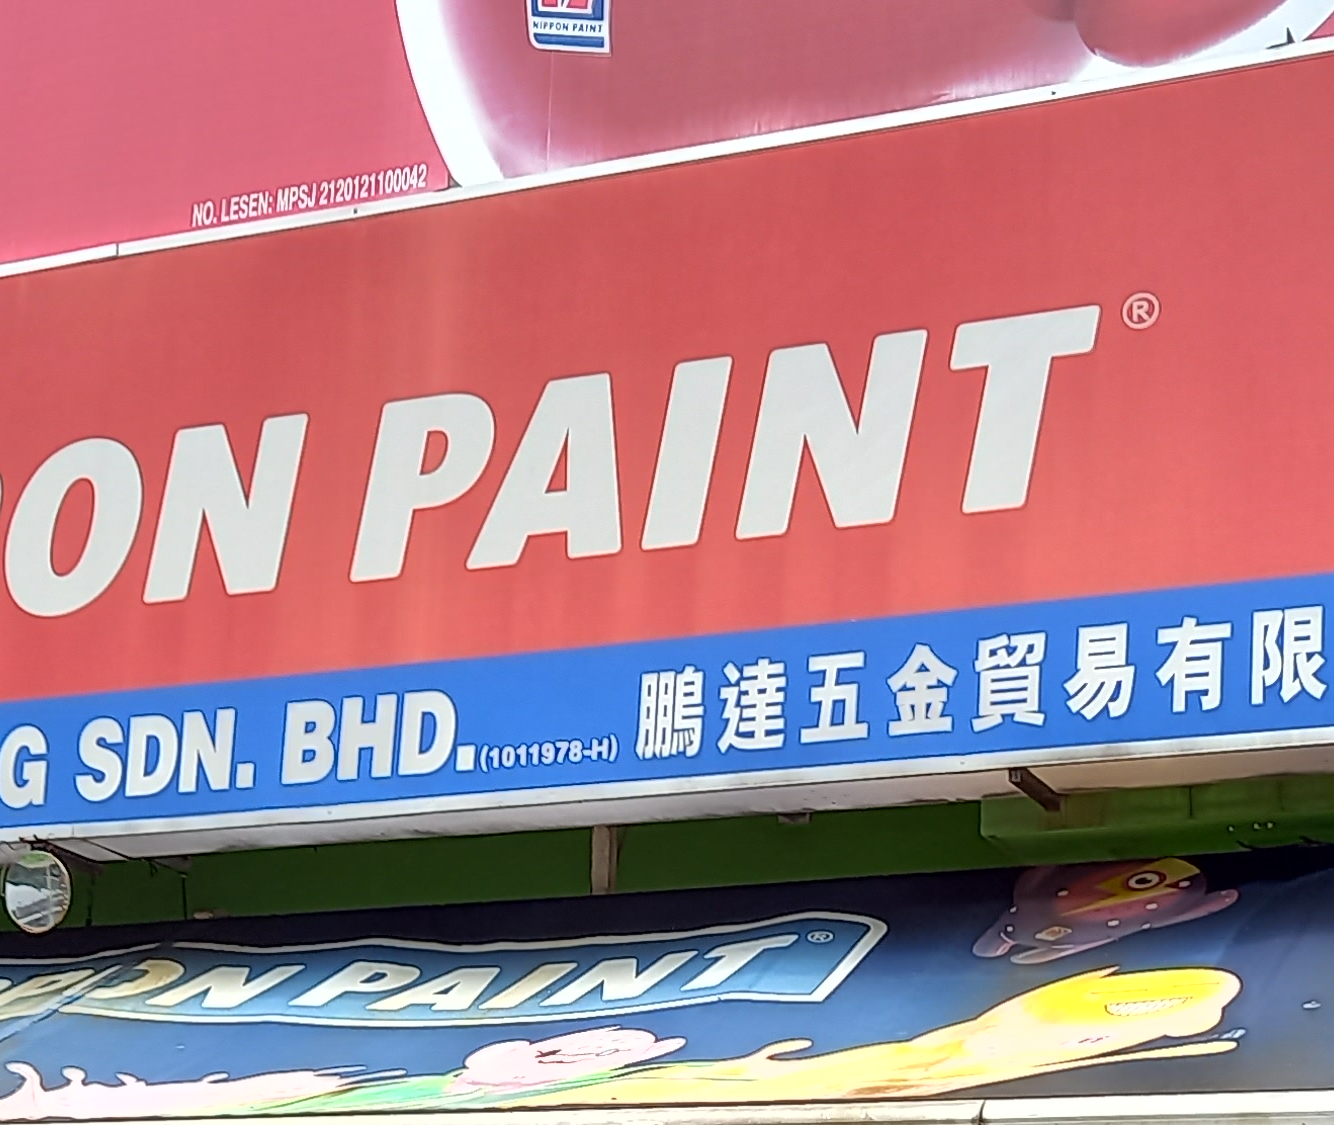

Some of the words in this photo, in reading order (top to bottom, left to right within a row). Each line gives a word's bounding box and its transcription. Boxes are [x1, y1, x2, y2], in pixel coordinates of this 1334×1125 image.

[532, 20, 569, 32] NIPPON
[572, 22, 603, 33] PAINT
[191, 201, 217, 227] NO.
[220, 191, 273, 222] LESEN:
[276, 183, 318, 212] MPSJ
[319, 163, 428, 206] 2120121100042
[348, 304, 1103, 584] PAINT
[75, 708, 256, 802] SDN.
[281, 690, 476, 785] BHD.
[478, 734, 620, 772] (1011978-H)
[287, 932, 801, 1013] PAINT
